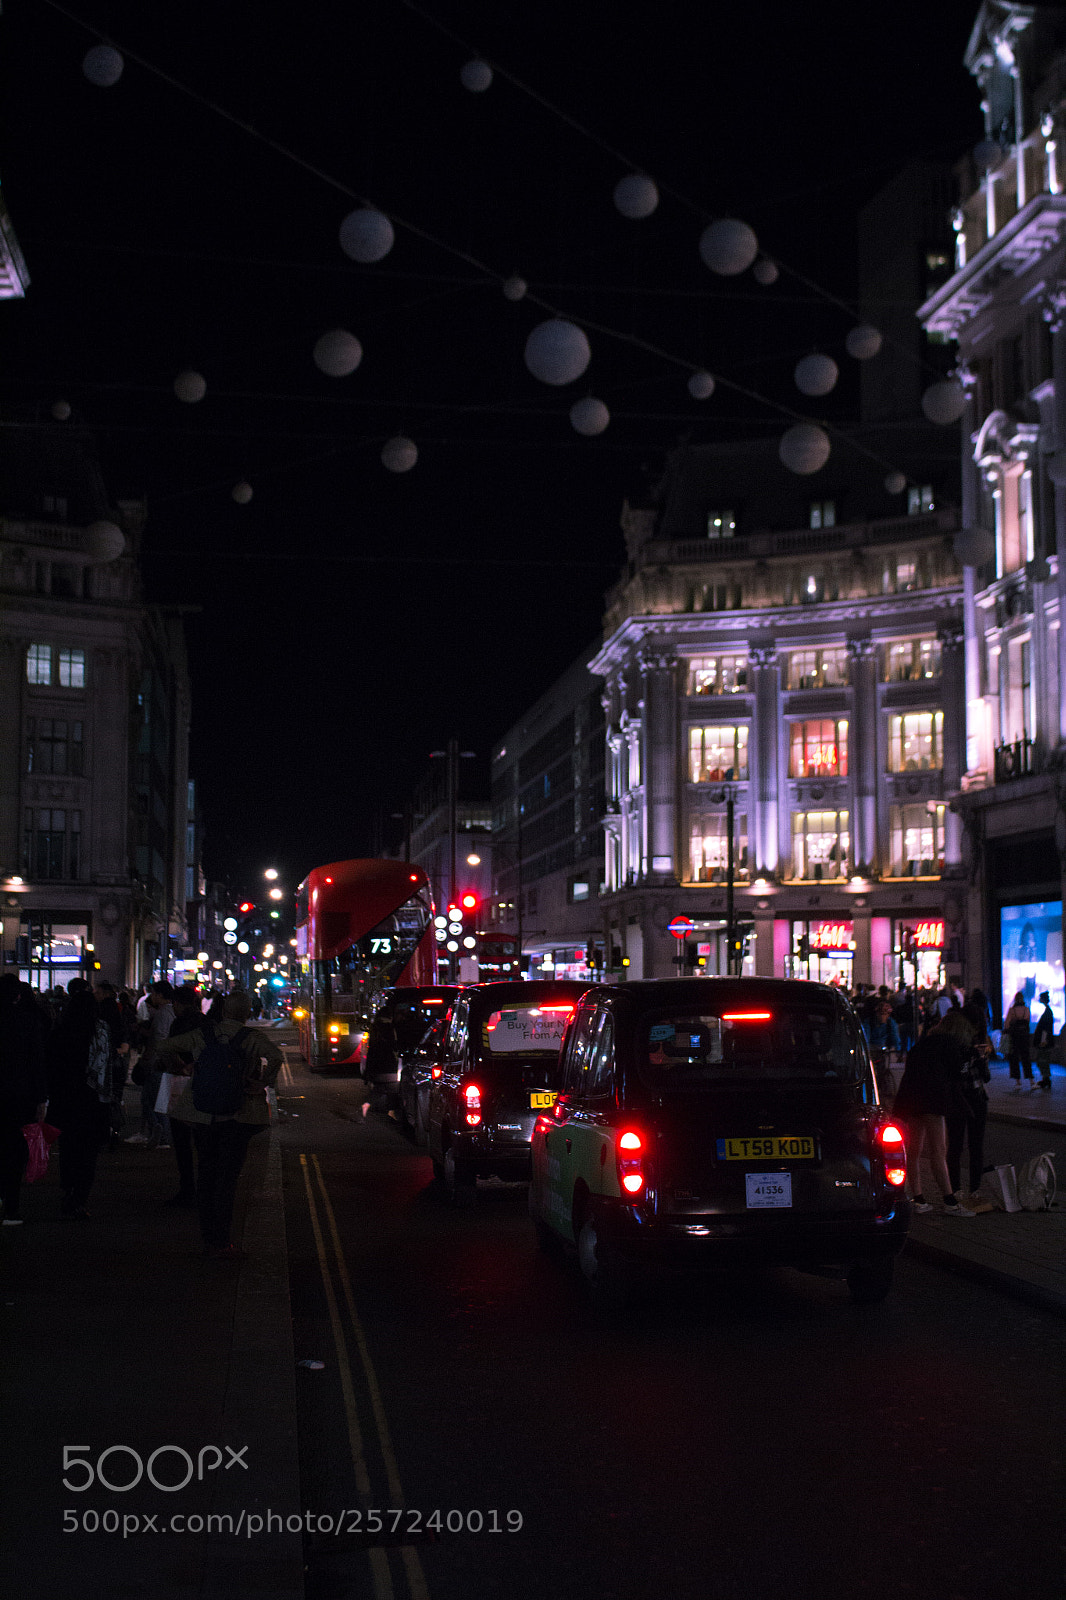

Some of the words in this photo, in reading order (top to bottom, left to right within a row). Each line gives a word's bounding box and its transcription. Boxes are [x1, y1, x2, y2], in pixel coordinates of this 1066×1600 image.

[370, 938, 392, 954] 73
[507, 1021, 528, 1030] Buy
[530, 1020, 554, 1028] Your
[523, 1031, 550, 1039] From
[728, 1140, 774, 1157] LT58
[778, 1139, 811, 1156] KOD
[754, 1185, 784, 1195] 41536
